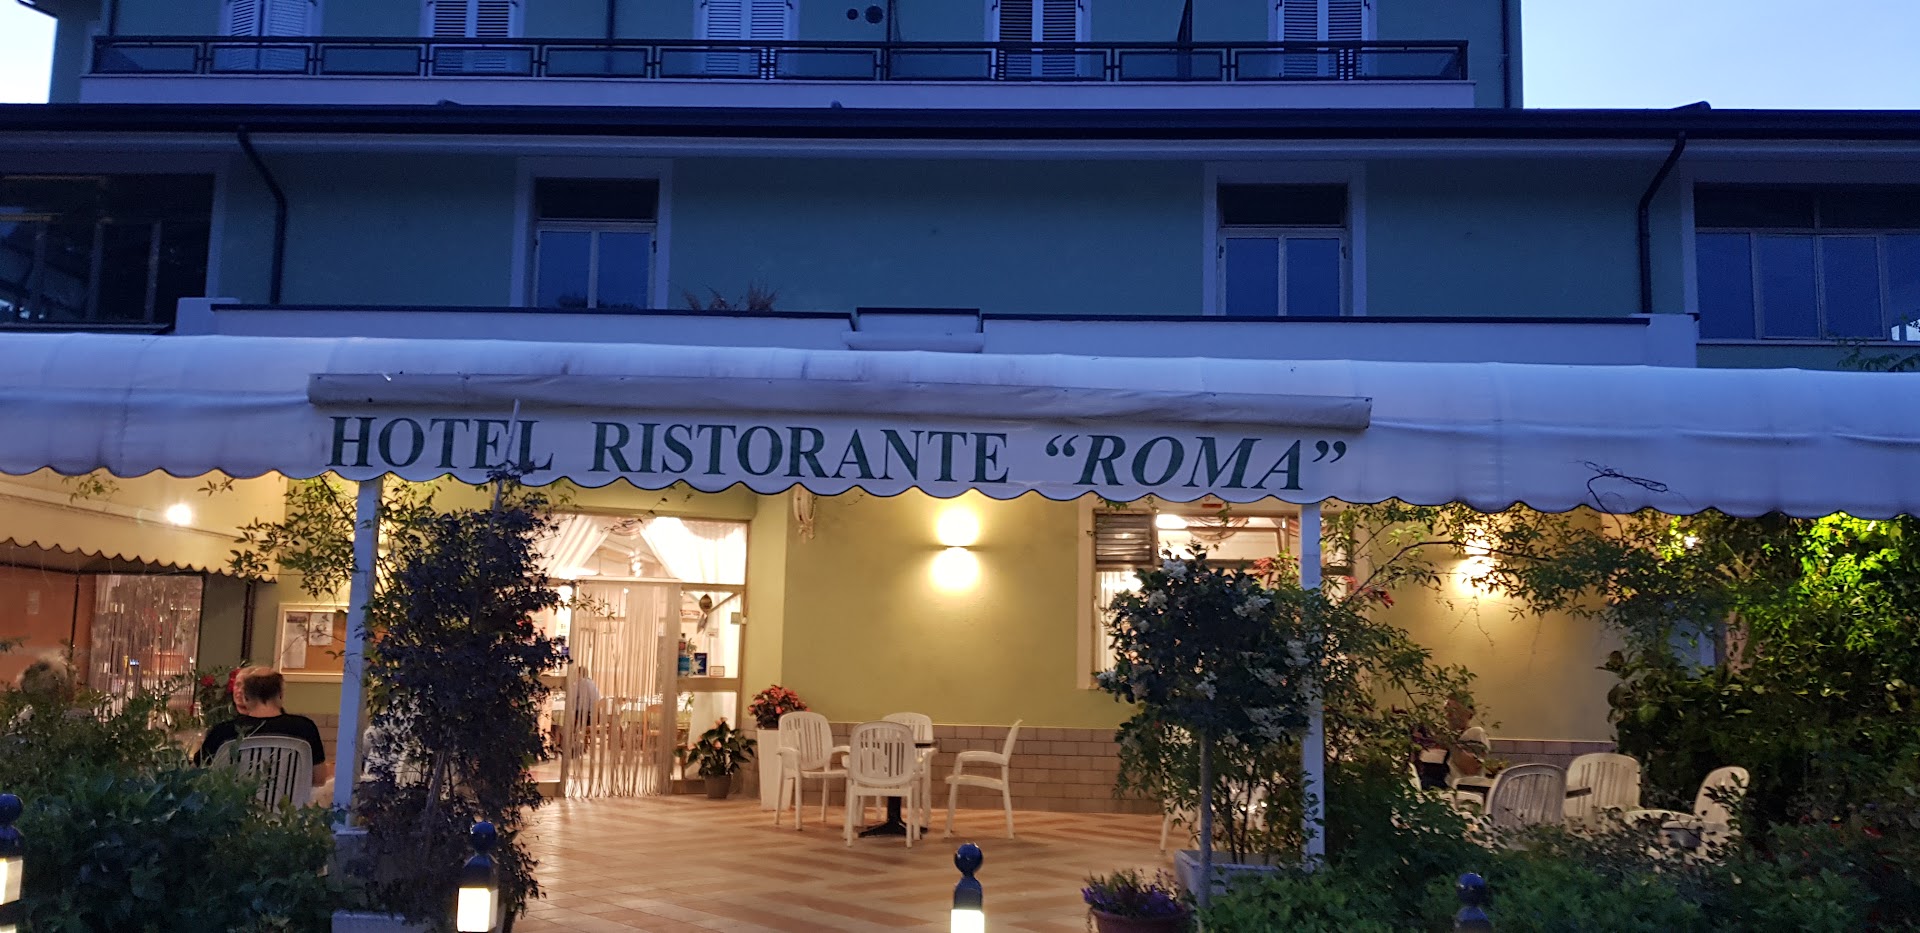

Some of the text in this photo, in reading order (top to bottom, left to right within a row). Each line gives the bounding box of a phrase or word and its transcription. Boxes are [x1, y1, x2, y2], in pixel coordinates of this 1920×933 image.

[328, 415, 1347, 491] HOTEL RISTORANTE “ROMA”
